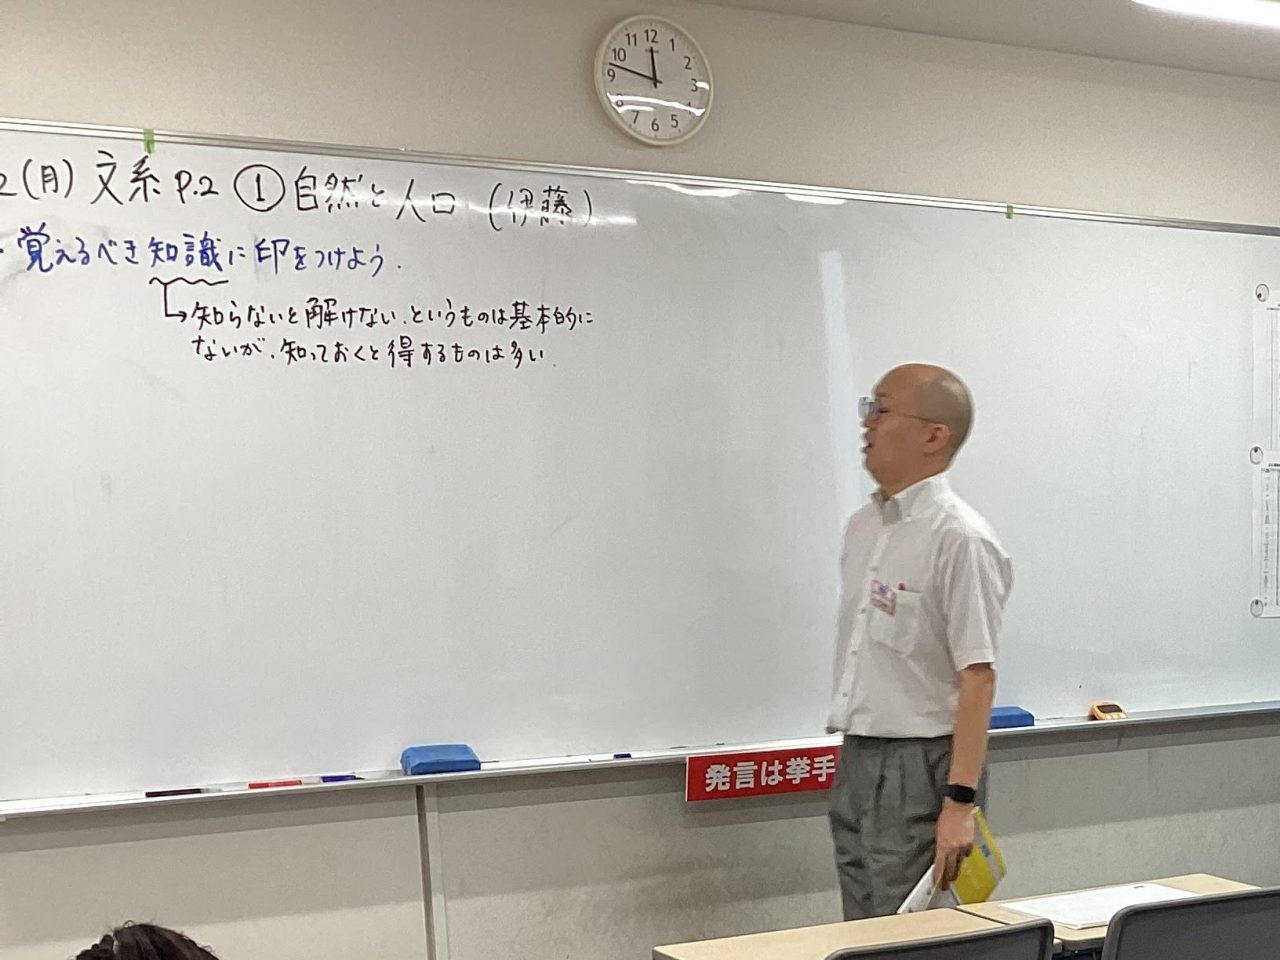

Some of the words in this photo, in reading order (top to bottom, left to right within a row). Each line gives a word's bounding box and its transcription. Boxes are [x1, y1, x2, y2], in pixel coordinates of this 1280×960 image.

[626, 33, 637, 46] 11
[644, 29, 659, 43] 12
[669, 38, 675, 51] 1
[612, 47, 626, 62] 10
[684, 55, 692, 70] 2
[607, 68, 616, 82] 9
[691, 78, 698, 92] 3
[632, 110, 640, 124] 7
[671, 114, 679, 128] 5
[651, 118, 659, 132] 6
[705, 755, 836, 792] 発言は挙手
